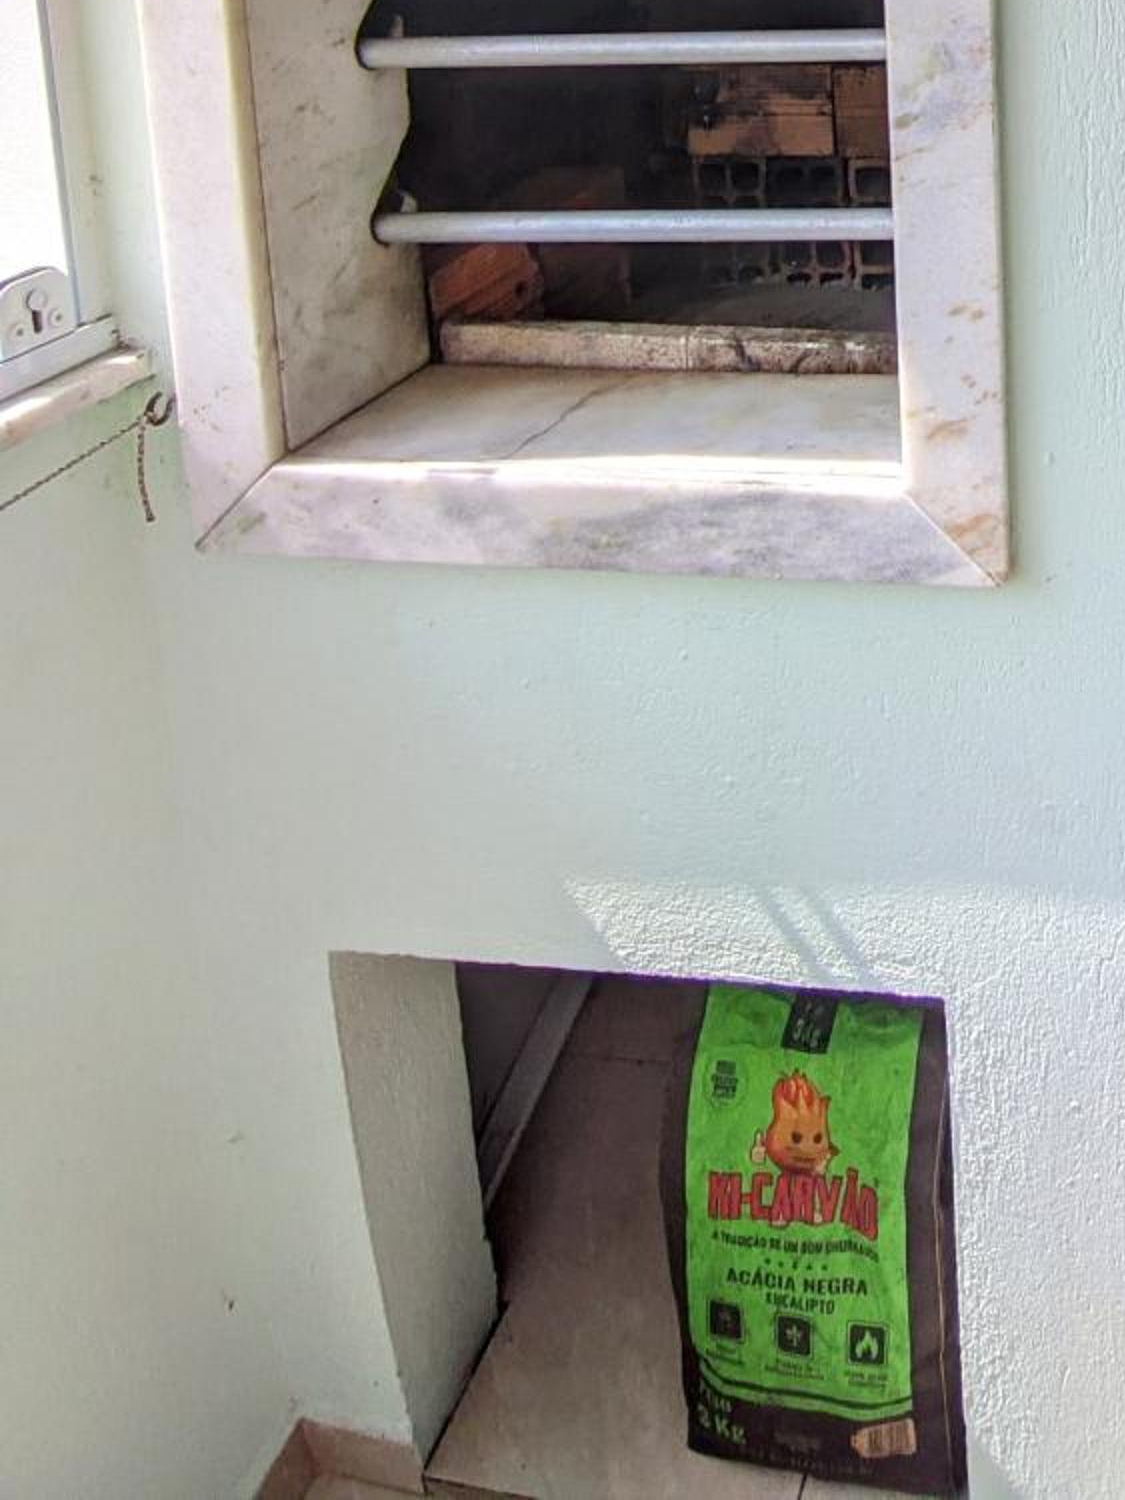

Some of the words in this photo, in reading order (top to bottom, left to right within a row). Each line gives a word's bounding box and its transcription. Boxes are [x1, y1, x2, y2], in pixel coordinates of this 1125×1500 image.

[726, 1266, 796, 1293] ACÁCIA
[803, 1276, 868, 1297] NEGRA
[765, 1291, 835, 1315] EUCALIPTO
